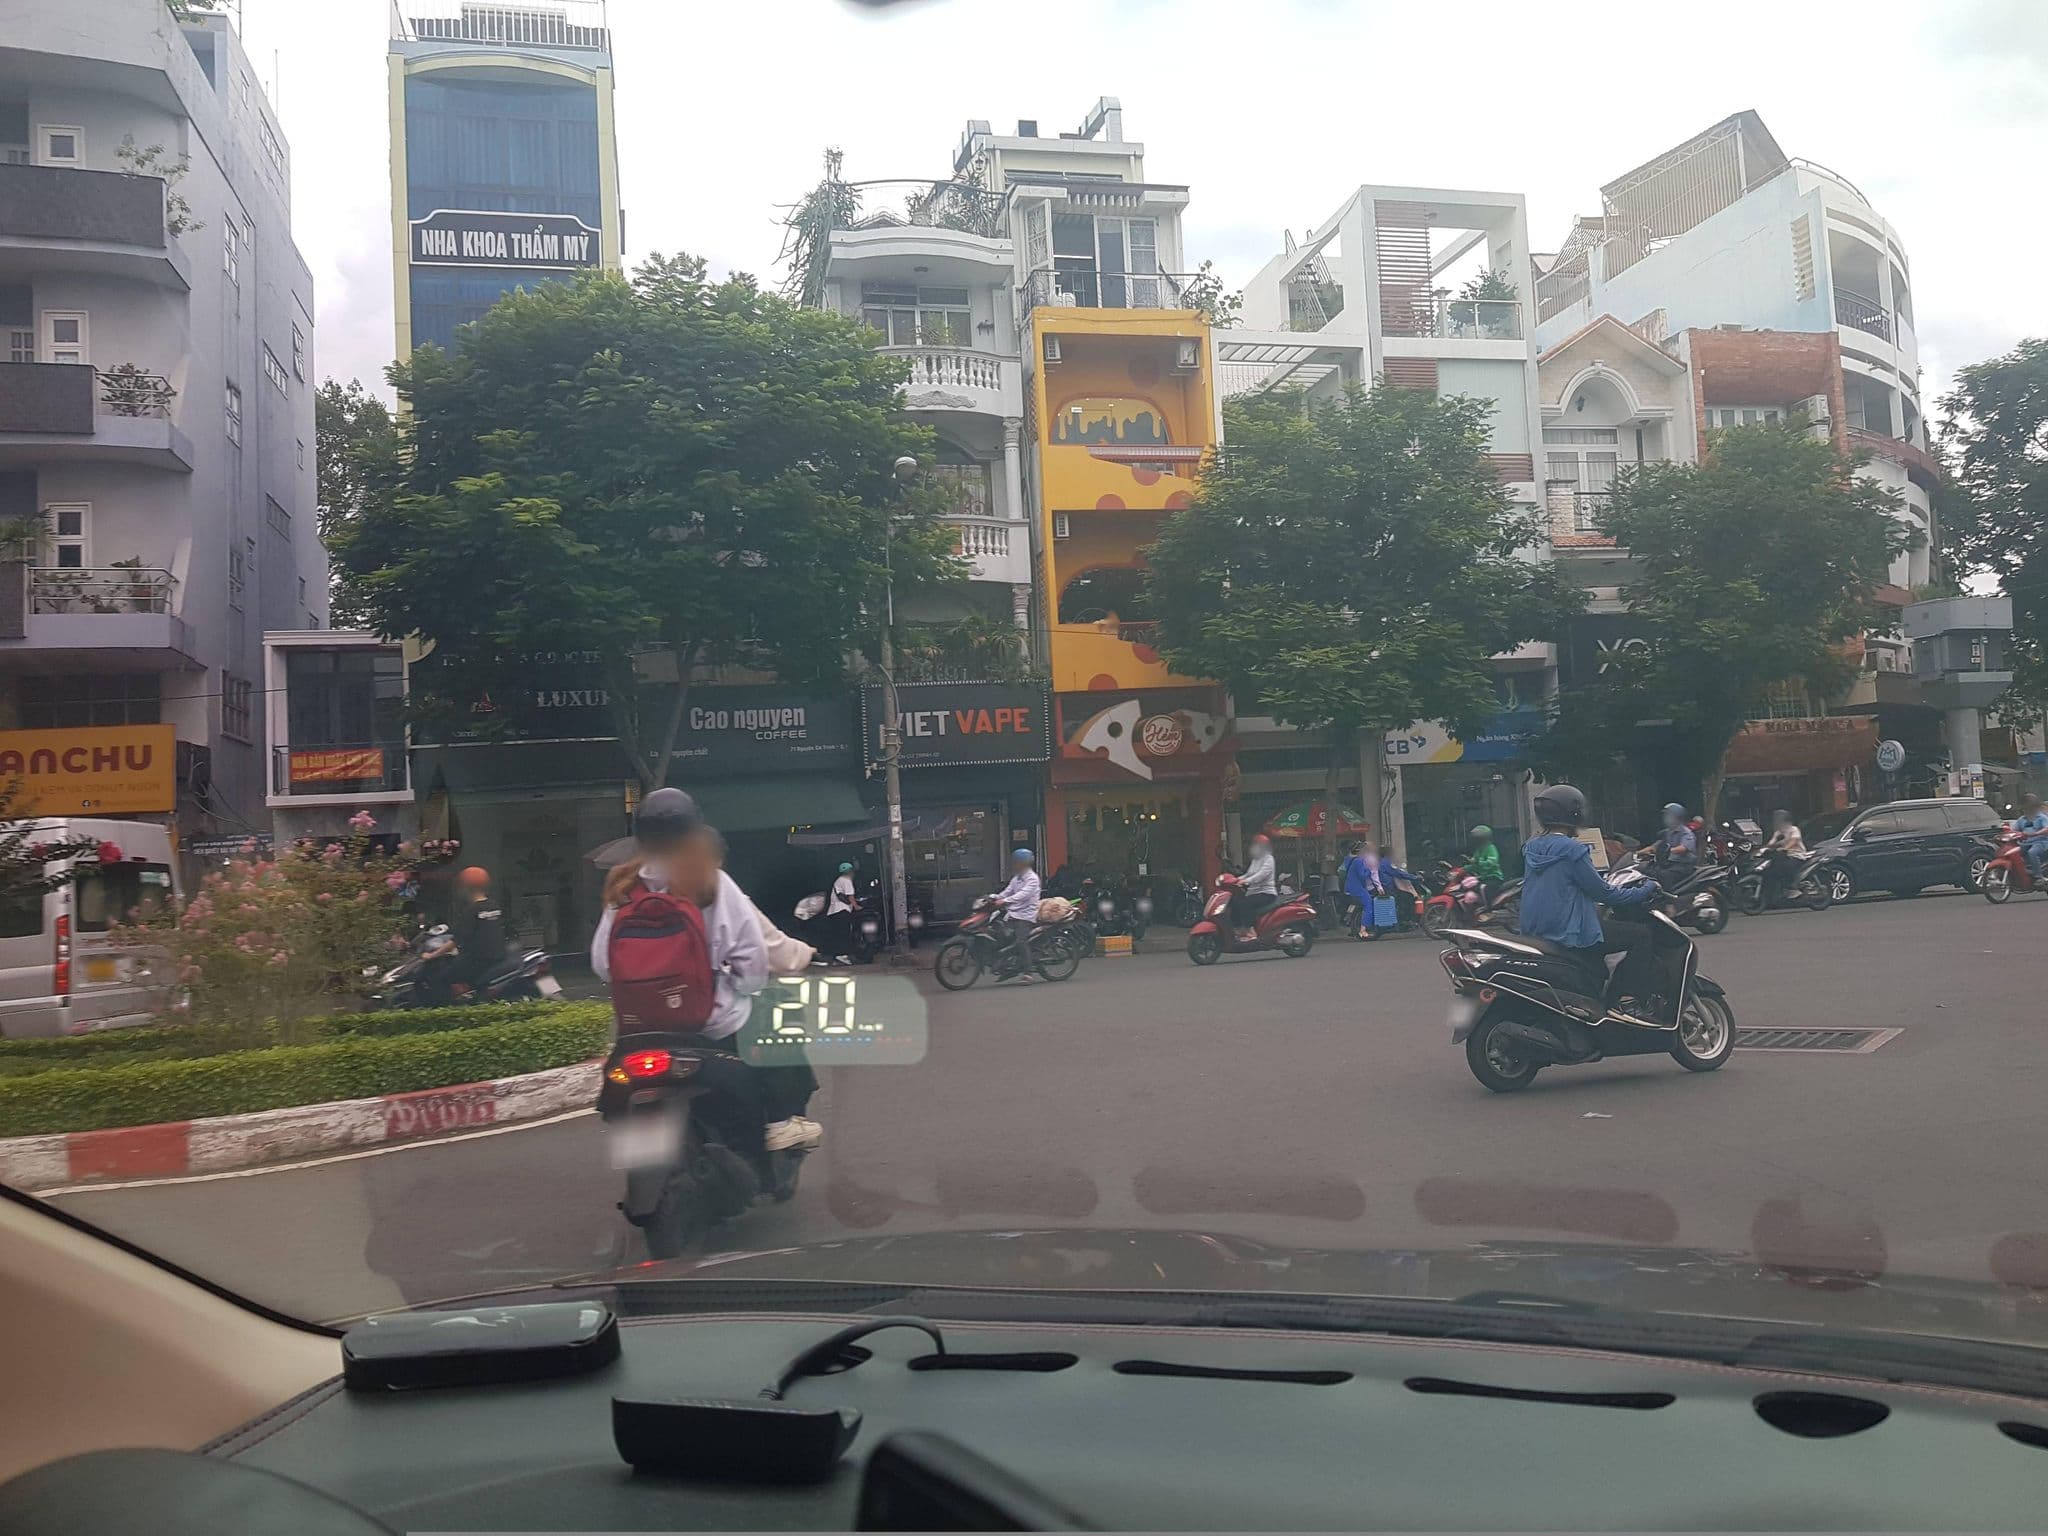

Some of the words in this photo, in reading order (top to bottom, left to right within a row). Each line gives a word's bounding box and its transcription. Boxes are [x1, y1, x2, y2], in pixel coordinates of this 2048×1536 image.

[421, 229, 457, 256] NHA
[462, 231, 508, 258] KHOA
[511, 224, 558, 260] THẨM
[564, 231, 589, 261] MỸ
[690, 707, 728, 730] Cao
[955, 707, 1031, 735] VAPE
[755, 729, 807, 741] COFFEE
[773, 976, 856, 1035] 20
